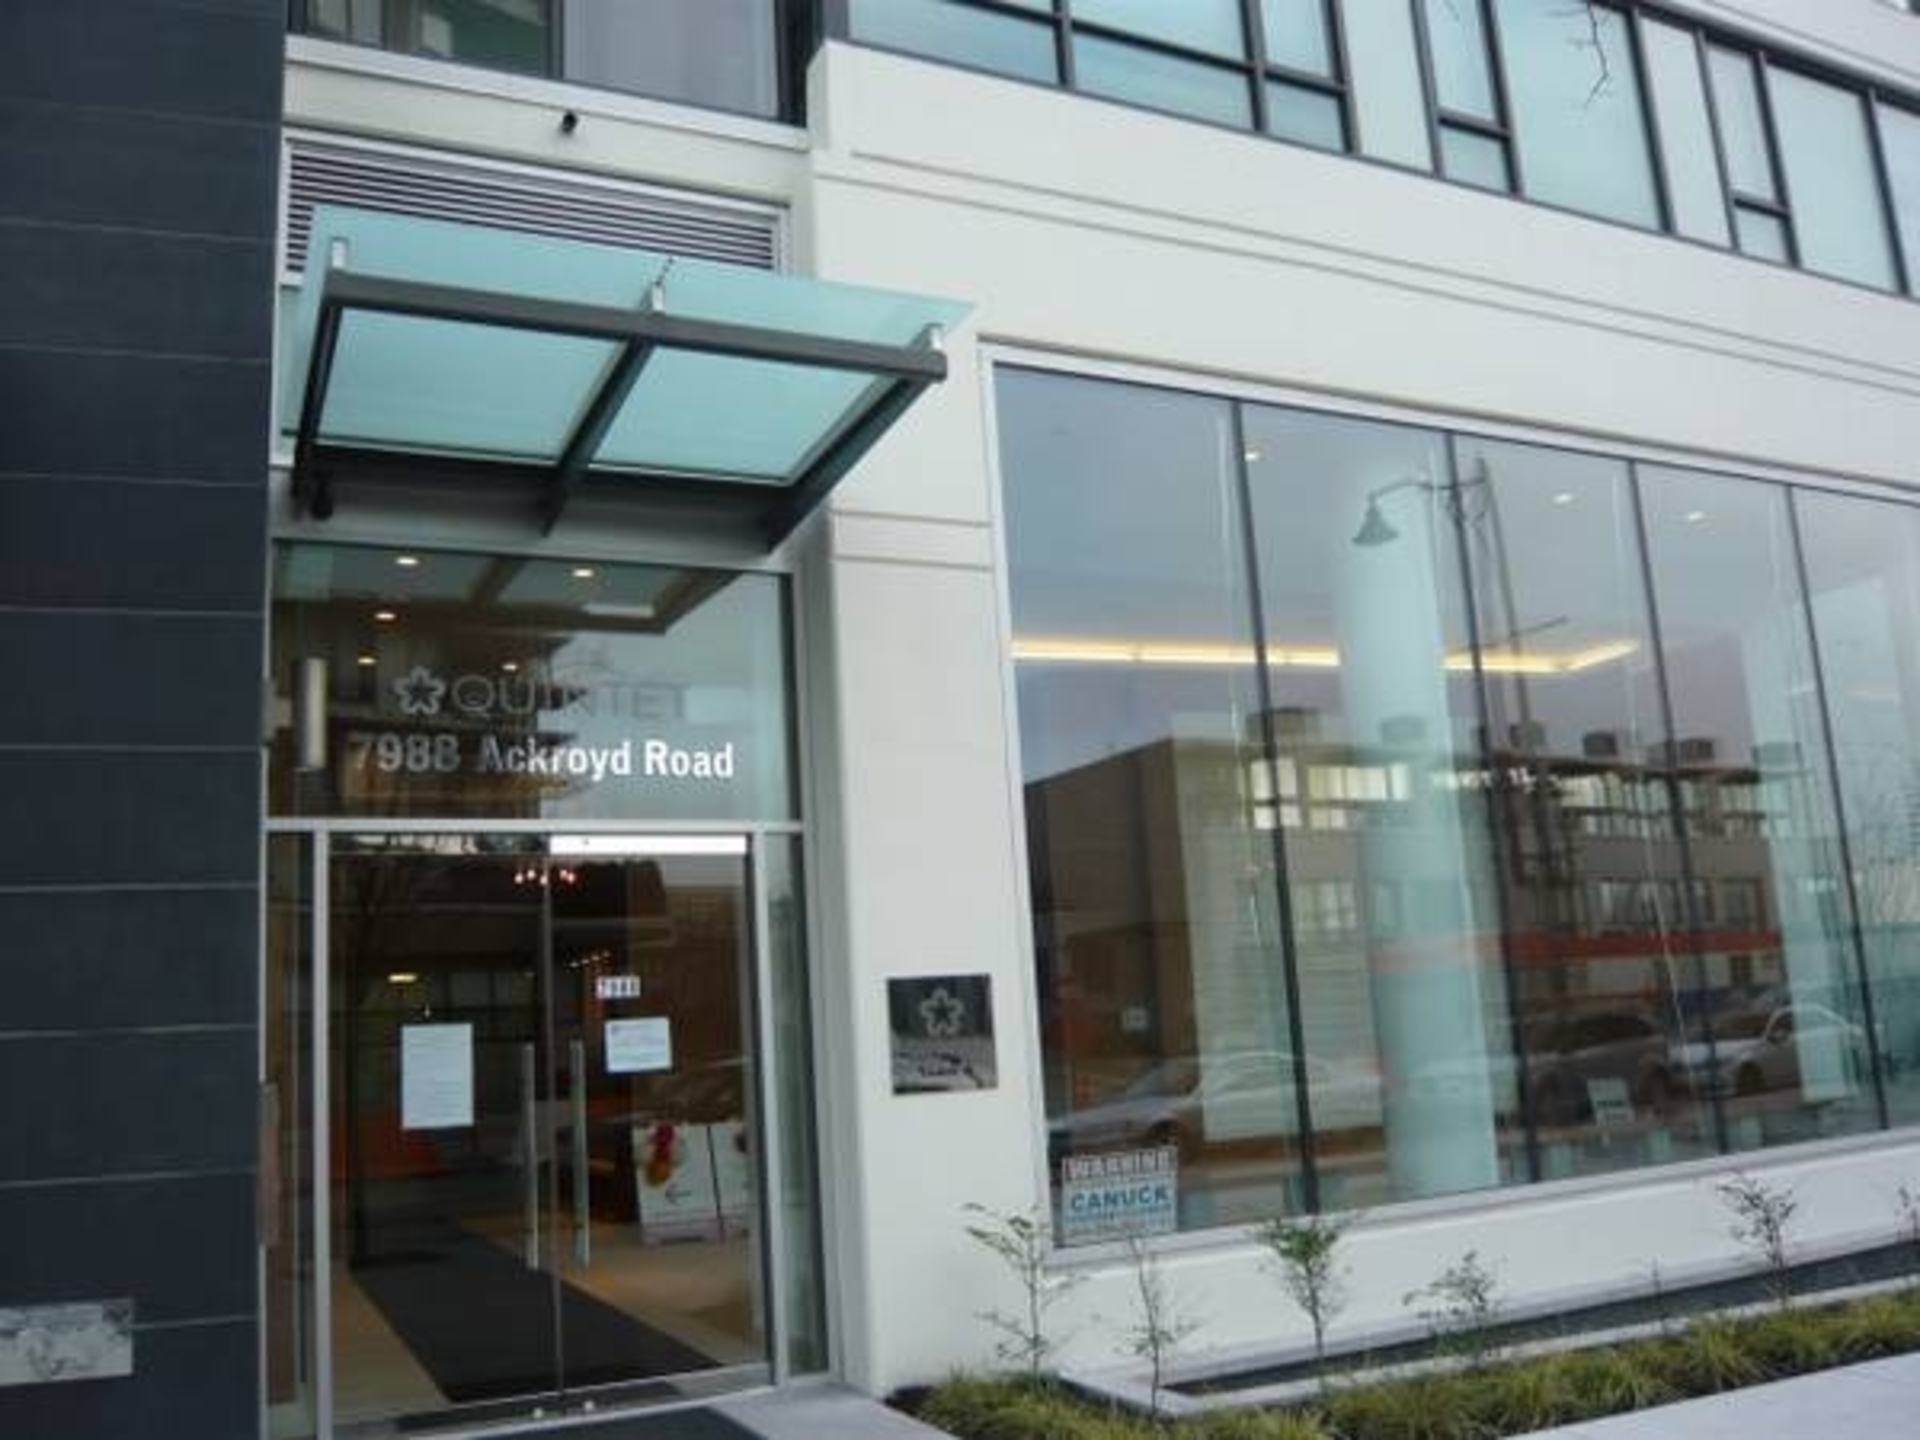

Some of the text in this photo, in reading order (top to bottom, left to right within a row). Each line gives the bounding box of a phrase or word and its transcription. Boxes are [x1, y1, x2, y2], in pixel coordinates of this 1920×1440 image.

[351, 733, 734, 780] 7988 Ackroyd Road
[1071, 1185, 1169, 1212] CANUCK
